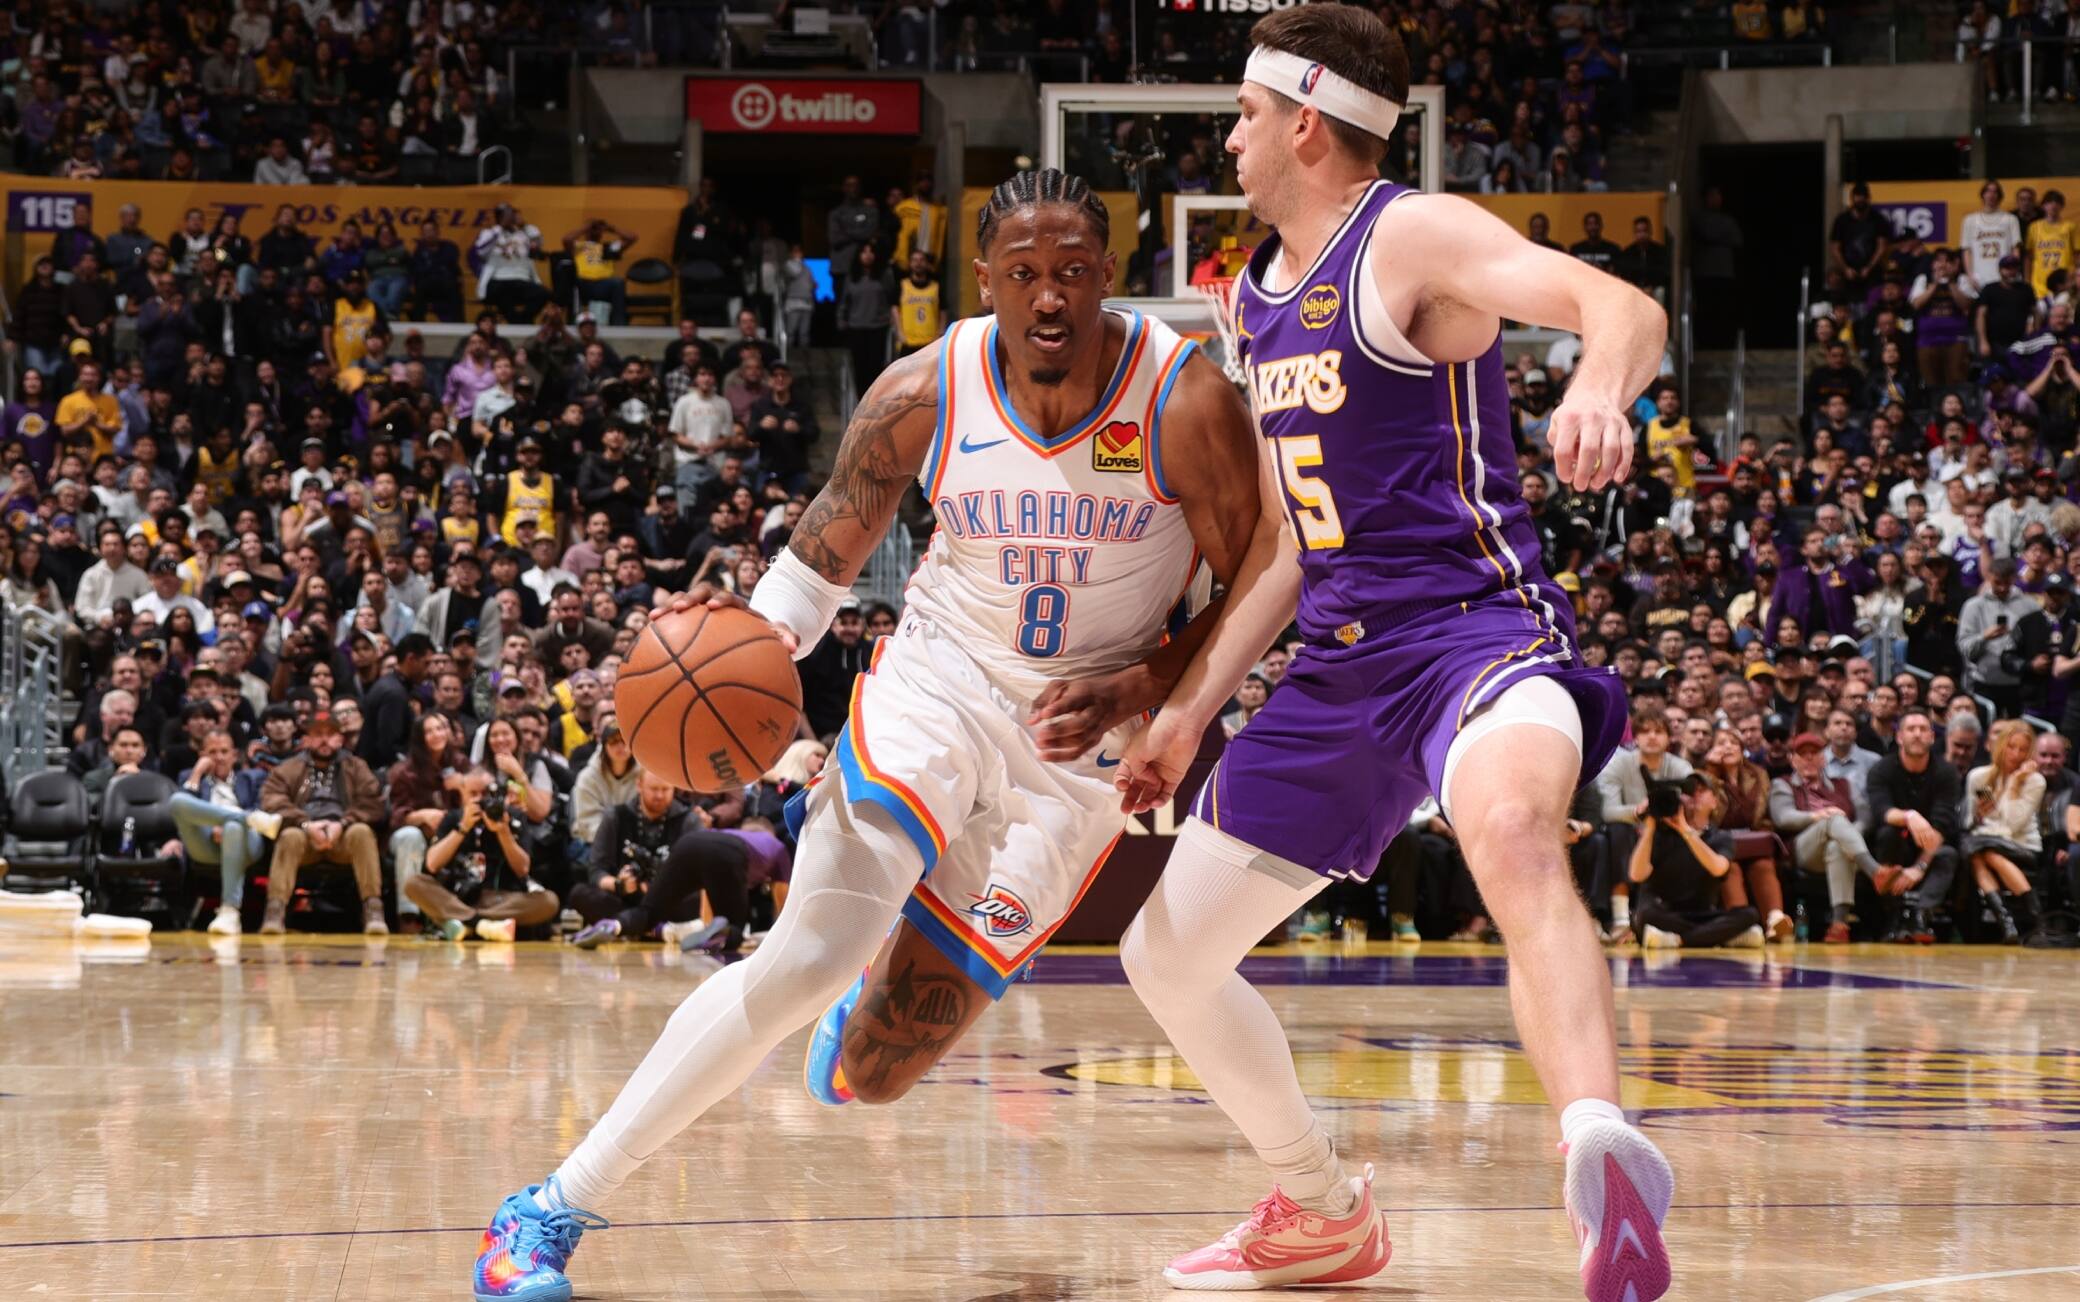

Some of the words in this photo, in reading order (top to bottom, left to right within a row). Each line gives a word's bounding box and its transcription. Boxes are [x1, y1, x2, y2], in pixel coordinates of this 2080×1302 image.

[780, 94, 876, 122] twilio
[21, 197, 77, 228] 115
[353, 204, 496, 228] ANGELE
[1303, 297, 1338, 315] bibigo
[938, 490, 1157, 542] OKLAHOMA
[1000, 545, 1094, 585] CITY
[1015, 582, 1071, 658] 8
[971, 899, 1025, 923] OKC
